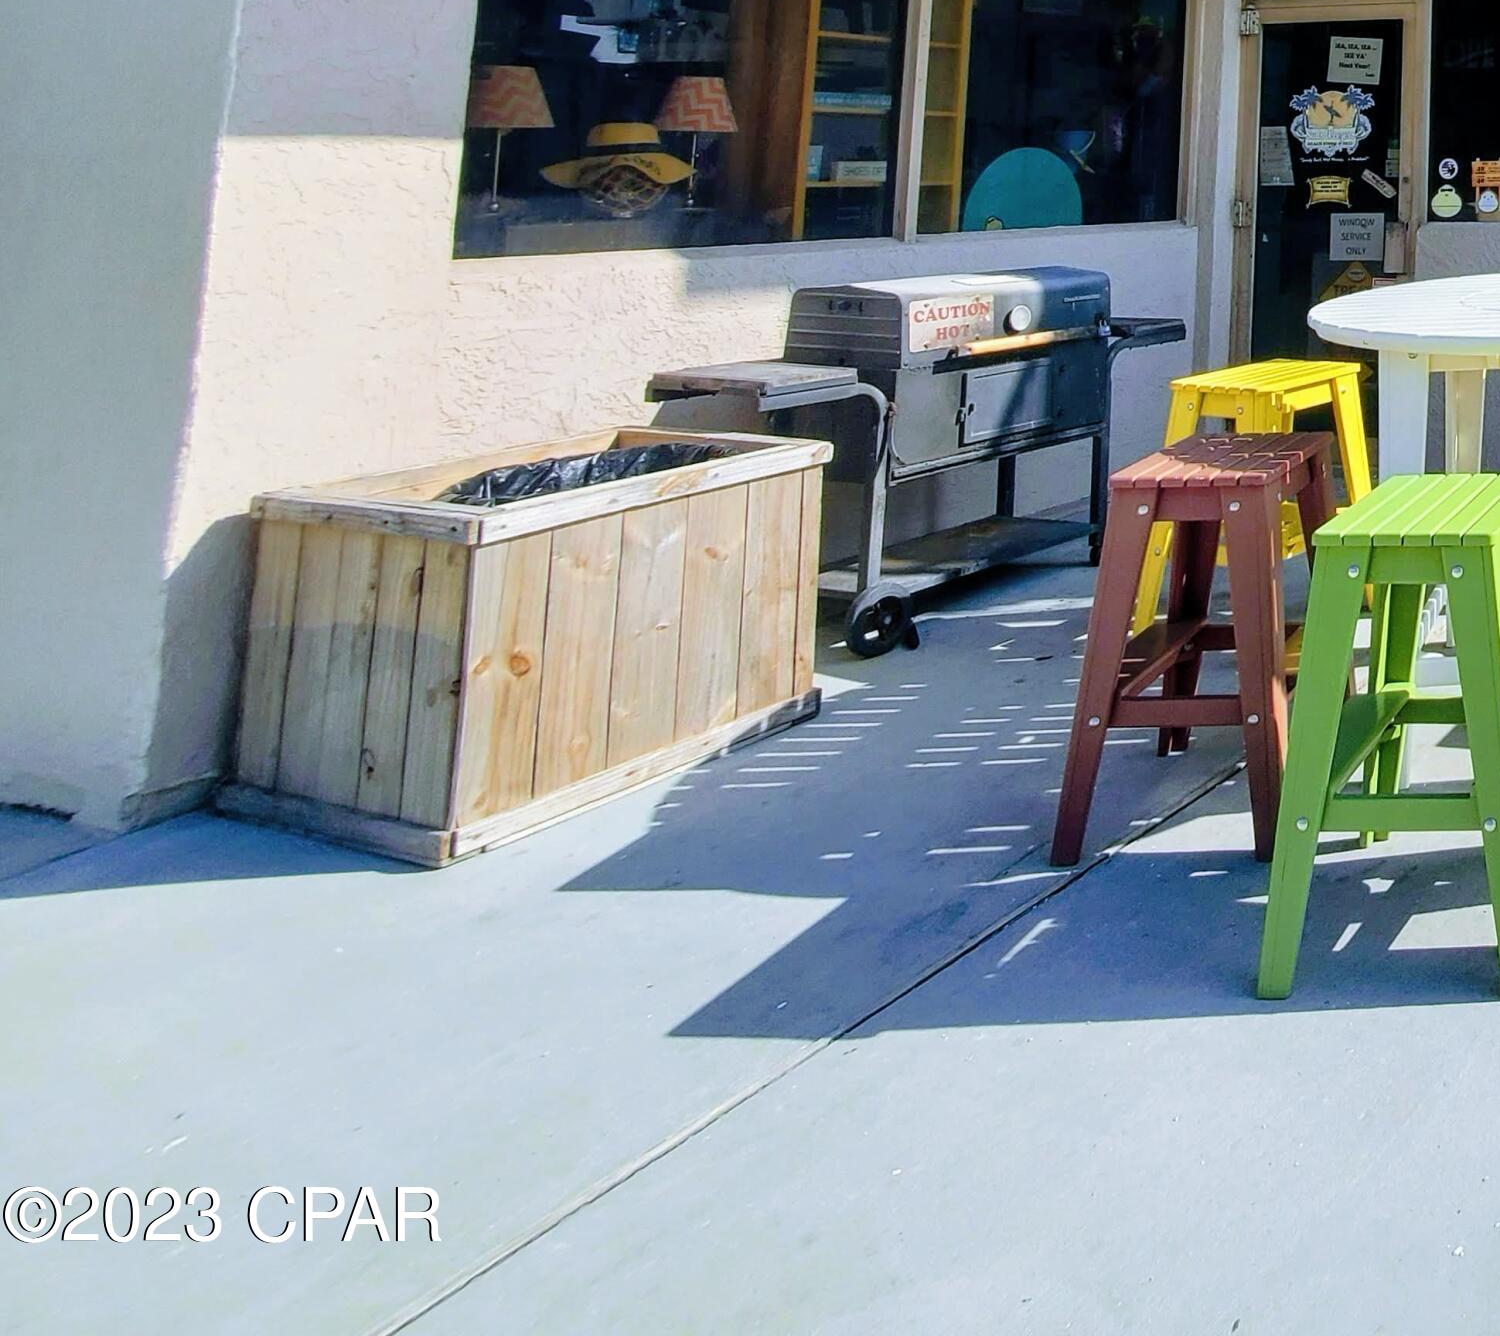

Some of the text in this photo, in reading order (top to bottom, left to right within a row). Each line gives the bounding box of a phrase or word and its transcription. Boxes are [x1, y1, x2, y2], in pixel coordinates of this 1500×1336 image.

[1338, 218, 1376, 228] WINDOW
[1341, 232, 1373, 241] SERVICE
[1345, 246, 1367, 256] ONLY
[913, 300, 991, 324] CAUTION
[935, 324, 971, 341] HOT
